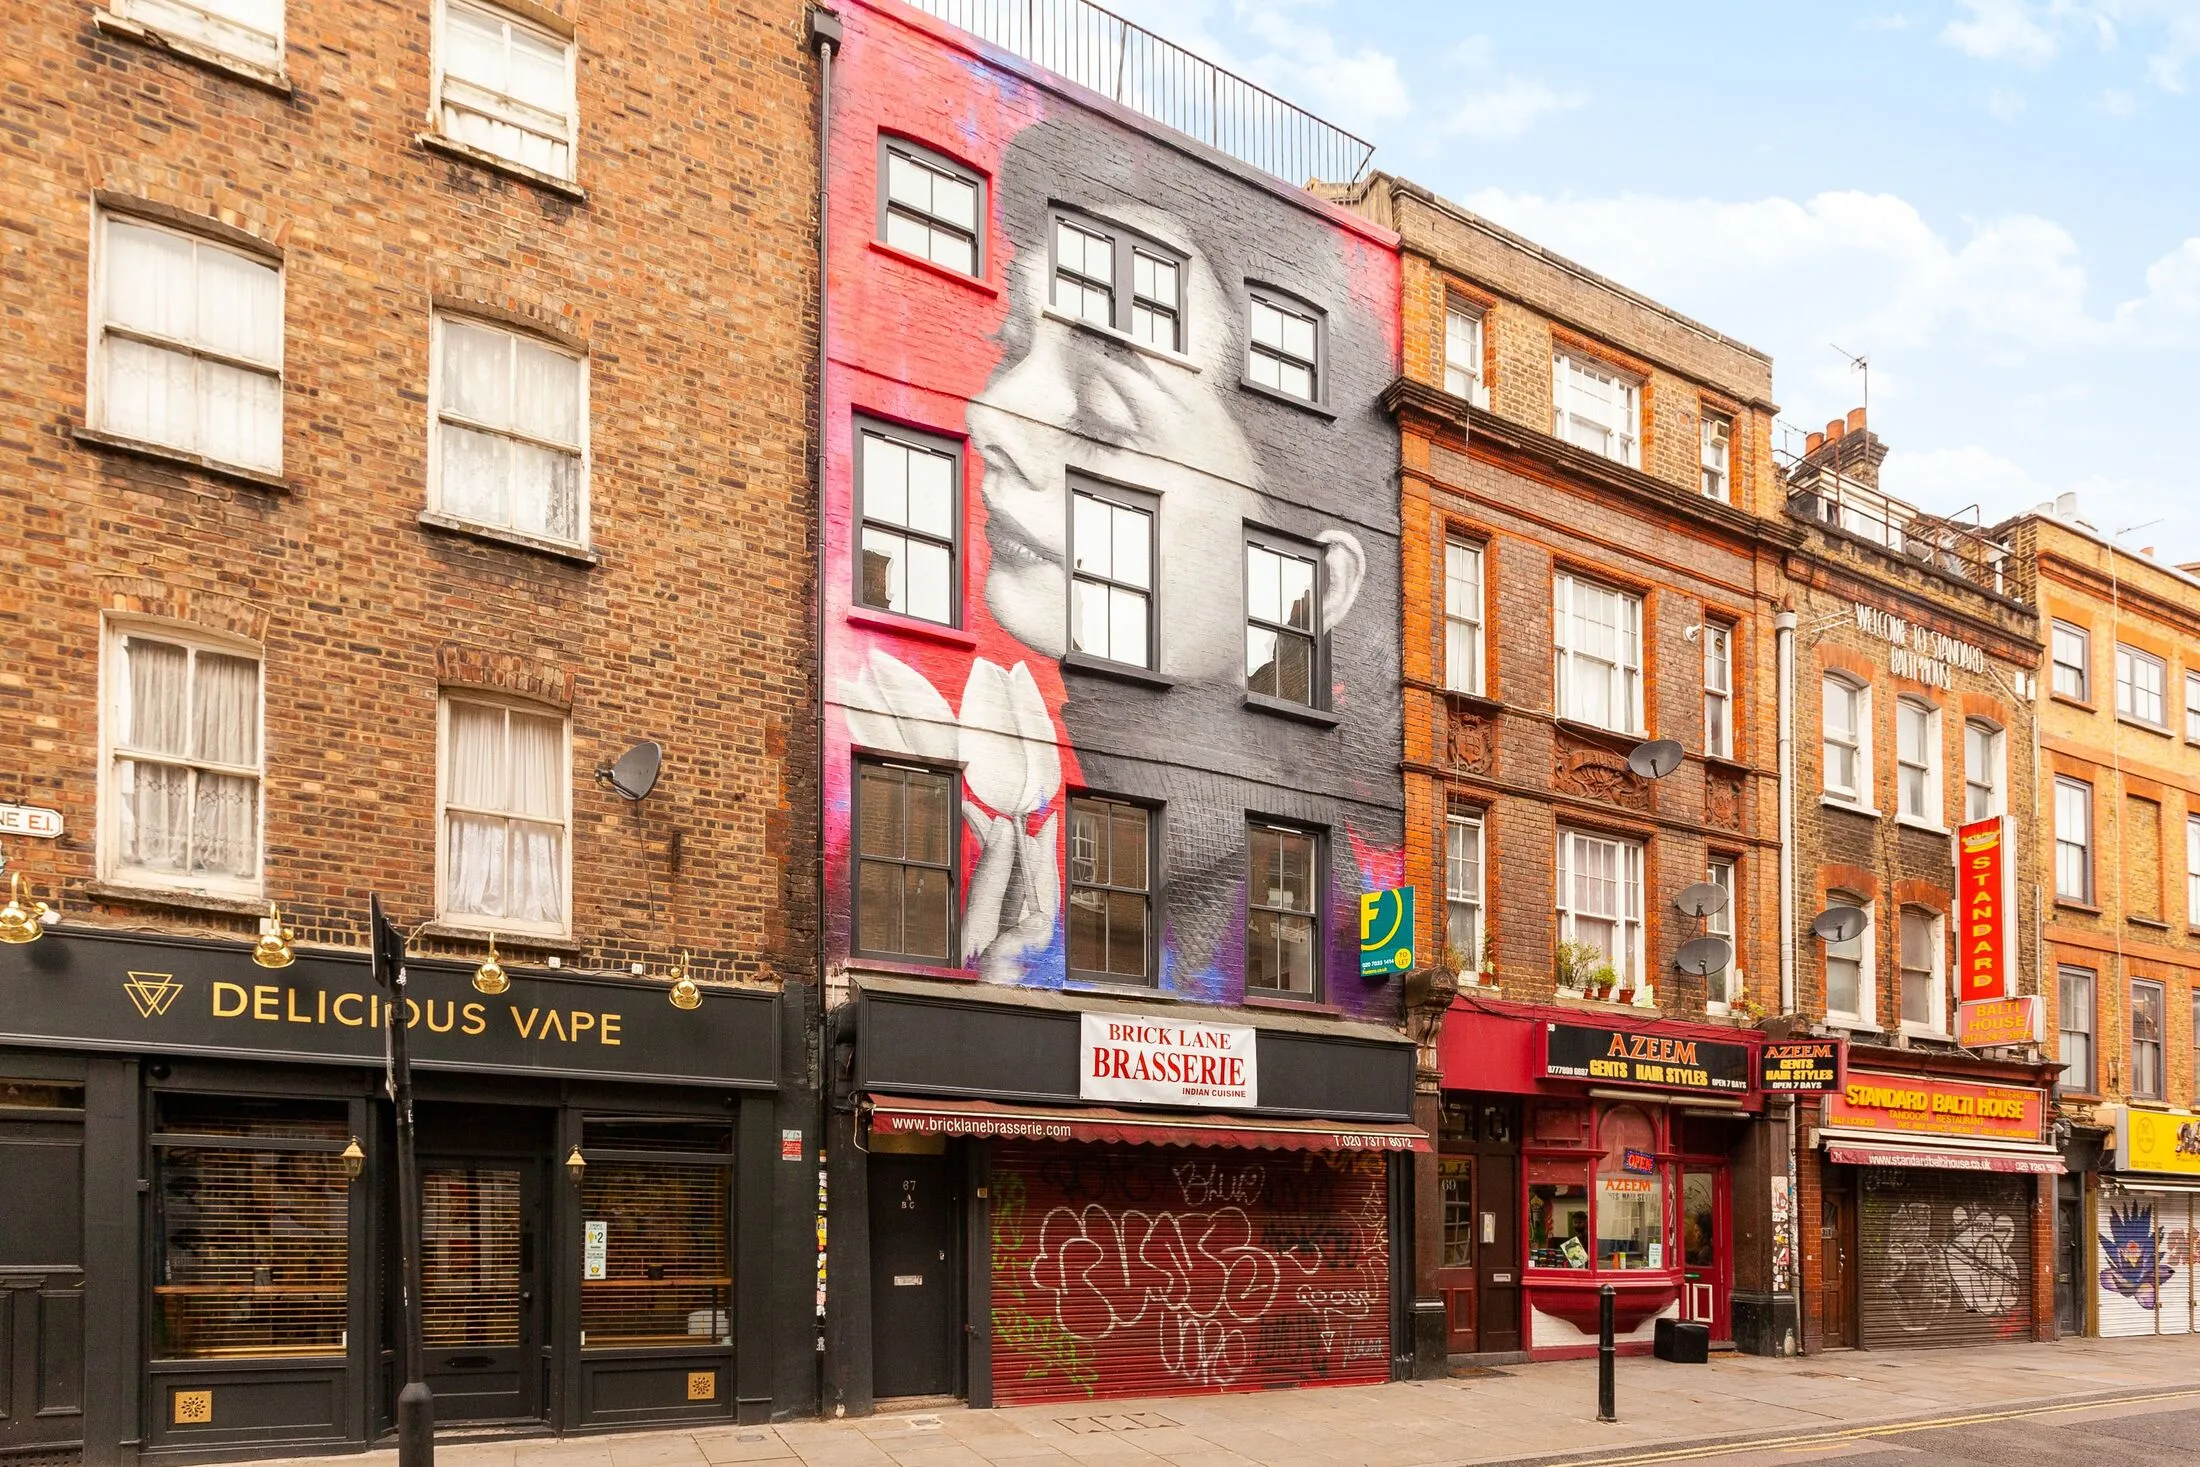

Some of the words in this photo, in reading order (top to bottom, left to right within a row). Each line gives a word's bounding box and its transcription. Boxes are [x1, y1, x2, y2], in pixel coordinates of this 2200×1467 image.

[1855, 602, 1908, 645] WELCOME
[1912, 623, 1927, 653] TO
[1931, 631, 1983, 674] STANDARD
[1972, 856, 1993, 988] STANDARD
[1976, 1002, 2020, 1017] BALTI
[510, 1006, 621, 1046] VAPE
[1968, 1015, 2026, 1032] HOUSE
[1109, 1023, 1172, 1045] BRICK
[1179, 1030, 1231, 1050] LANE
[1607, 1033, 1699, 1066] AZEEM
[1764, 1045, 1834, 1058] AZEEM
[1092, 1047, 1246, 1086] BRASSERIE
[1780, 1059, 1814, 1069] GENTS
[1589, 1060, 1628, 1079] GENTS
[1635, 1064, 1664, 1083] HAIR
[1666, 1067, 1708, 1087] STYLES
[1712, 1078, 1726, 1087] OPEN
[1731, 1080, 1746, 1089] DAYS
[1766, 1070, 1791, 1080] HAIR
[1793, 1070, 1834, 1080] STYLES
[1182, 1087, 1210, 1096] INDIAN
[1211, 1090, 1246, 1098] CUISINE
[1846, 1084, 1928, 1111] STANDARD
[1932, 1093, 1974, 1115] BALTI
[1977, 1097, 2025, 1119] HOUSE
[1888, 1110, 1929, 1121] TANDOORI
[1935, 1114, 1985, 1126] RESTAURANT
[892, 1116, 1071, 1137] www.bricklanebrasserie.com
[1333, 1135, 1362, 1147] T.020
[1363, 1136, 1386, 1147] 7377
[1388, 1137, 1413, 1148] 8072
[1628, 1154, 1653, 1171] OPEN
[903, 1181, 916, 1190] 67
[1441, 1179, 1457, 1191] 69
[1605, 1178, 1652, 1192] AZEEM
[906, 1193, 912, 1201] A
